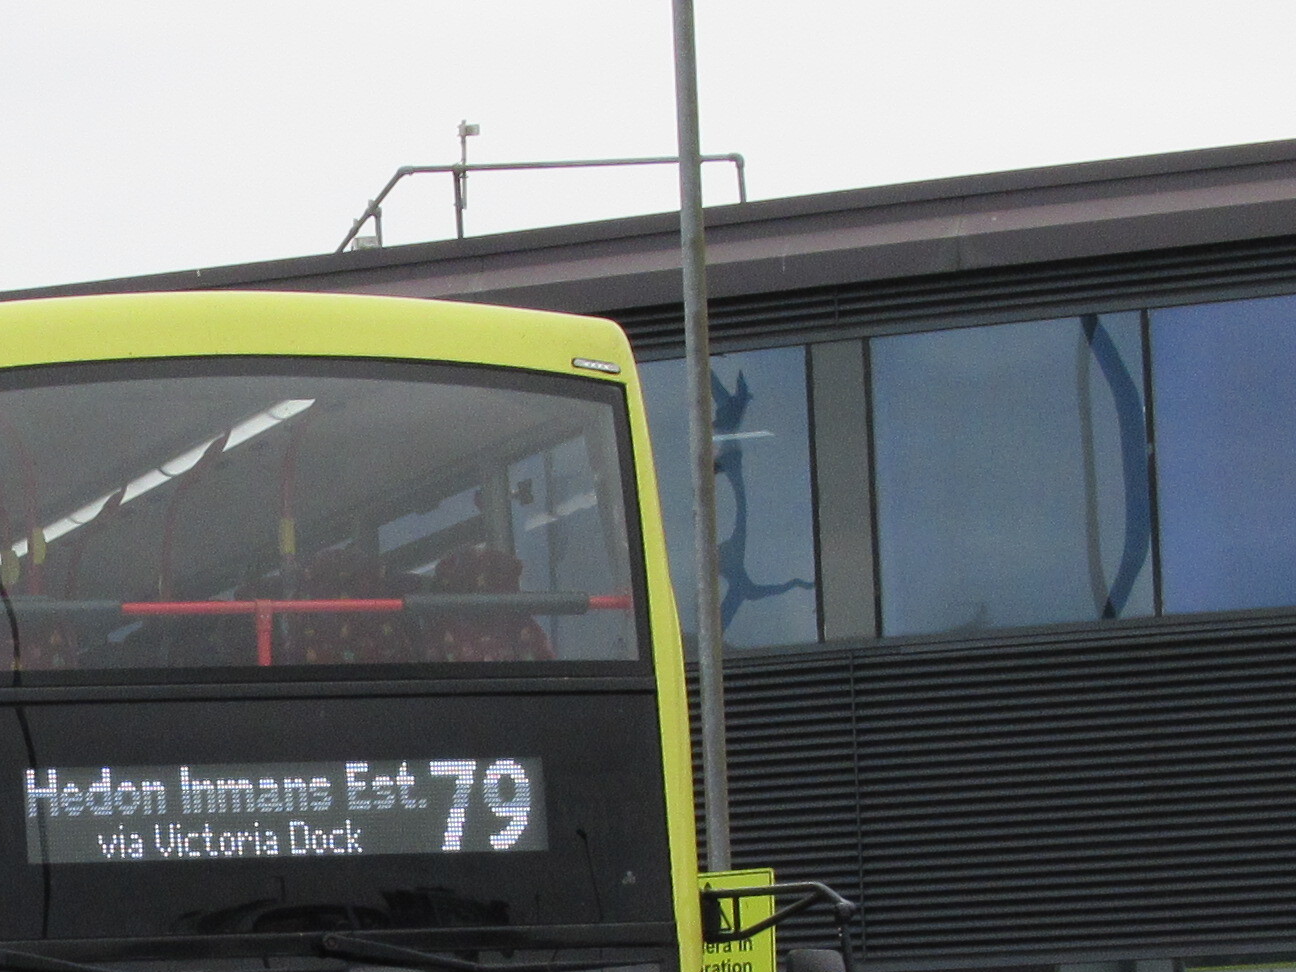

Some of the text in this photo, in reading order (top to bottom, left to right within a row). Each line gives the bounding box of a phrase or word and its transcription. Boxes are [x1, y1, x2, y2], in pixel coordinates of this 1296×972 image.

[25, 760, 429, 817] Hedon Inmans Est.
[430, 758, 532, 852] 79
[98, 819, 364, 860] via Victoria Dock
